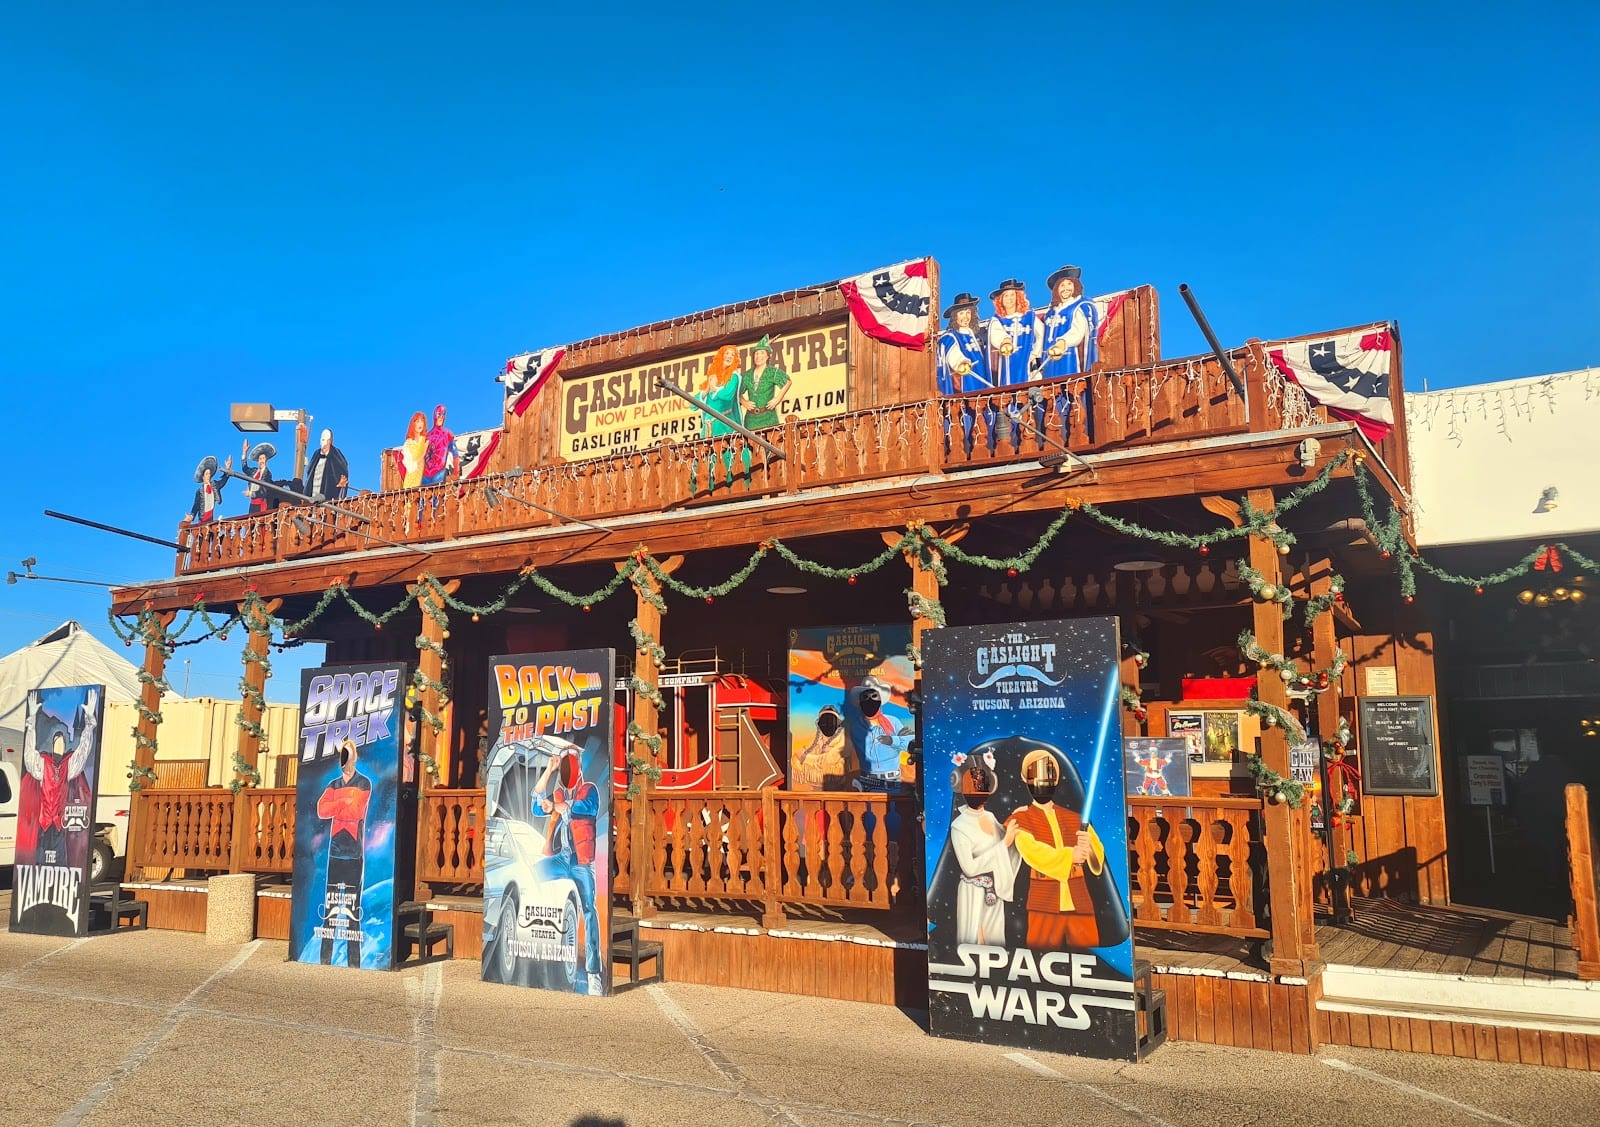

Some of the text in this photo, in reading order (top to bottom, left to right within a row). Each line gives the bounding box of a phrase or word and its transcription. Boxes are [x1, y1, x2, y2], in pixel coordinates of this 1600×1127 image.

[566, 361, 699, 434] GASLIGHT
[595, 410, 627, 427] NOW
[572, 427, 640, 452] GASLIGHT
[826, 633, 880, 654] GASLIGHT
[1007, 633, 1024, 644] THE
[976, 643, 1056, 675] GASLIGHT
[494, 664, 577, 709] BACK
[664, 676, 704, 685] COMPANY
[996, 680, 1039, 694] THEATRE
[303, 669, 399, 727] SPACE
[972, 697, 1066, 711] TUCSON, ARIZONA
[500, 697, 602, 745] THE PAST
[503, 707, 528, 727] TO
[301, 708, 393, 763] TREK
[45, 850, 57, 863] THE
[16, 864, 82, 935] VAMPIRE
[326, 892, 357, 911] GASLIGHT
[525, 905, 563, 924] GASLIGHT
[531, 929, 556, 940] THEATRE
[541, 944, 577, 962] ARIZONA
[928, 944, 1134, 993] SPACE
